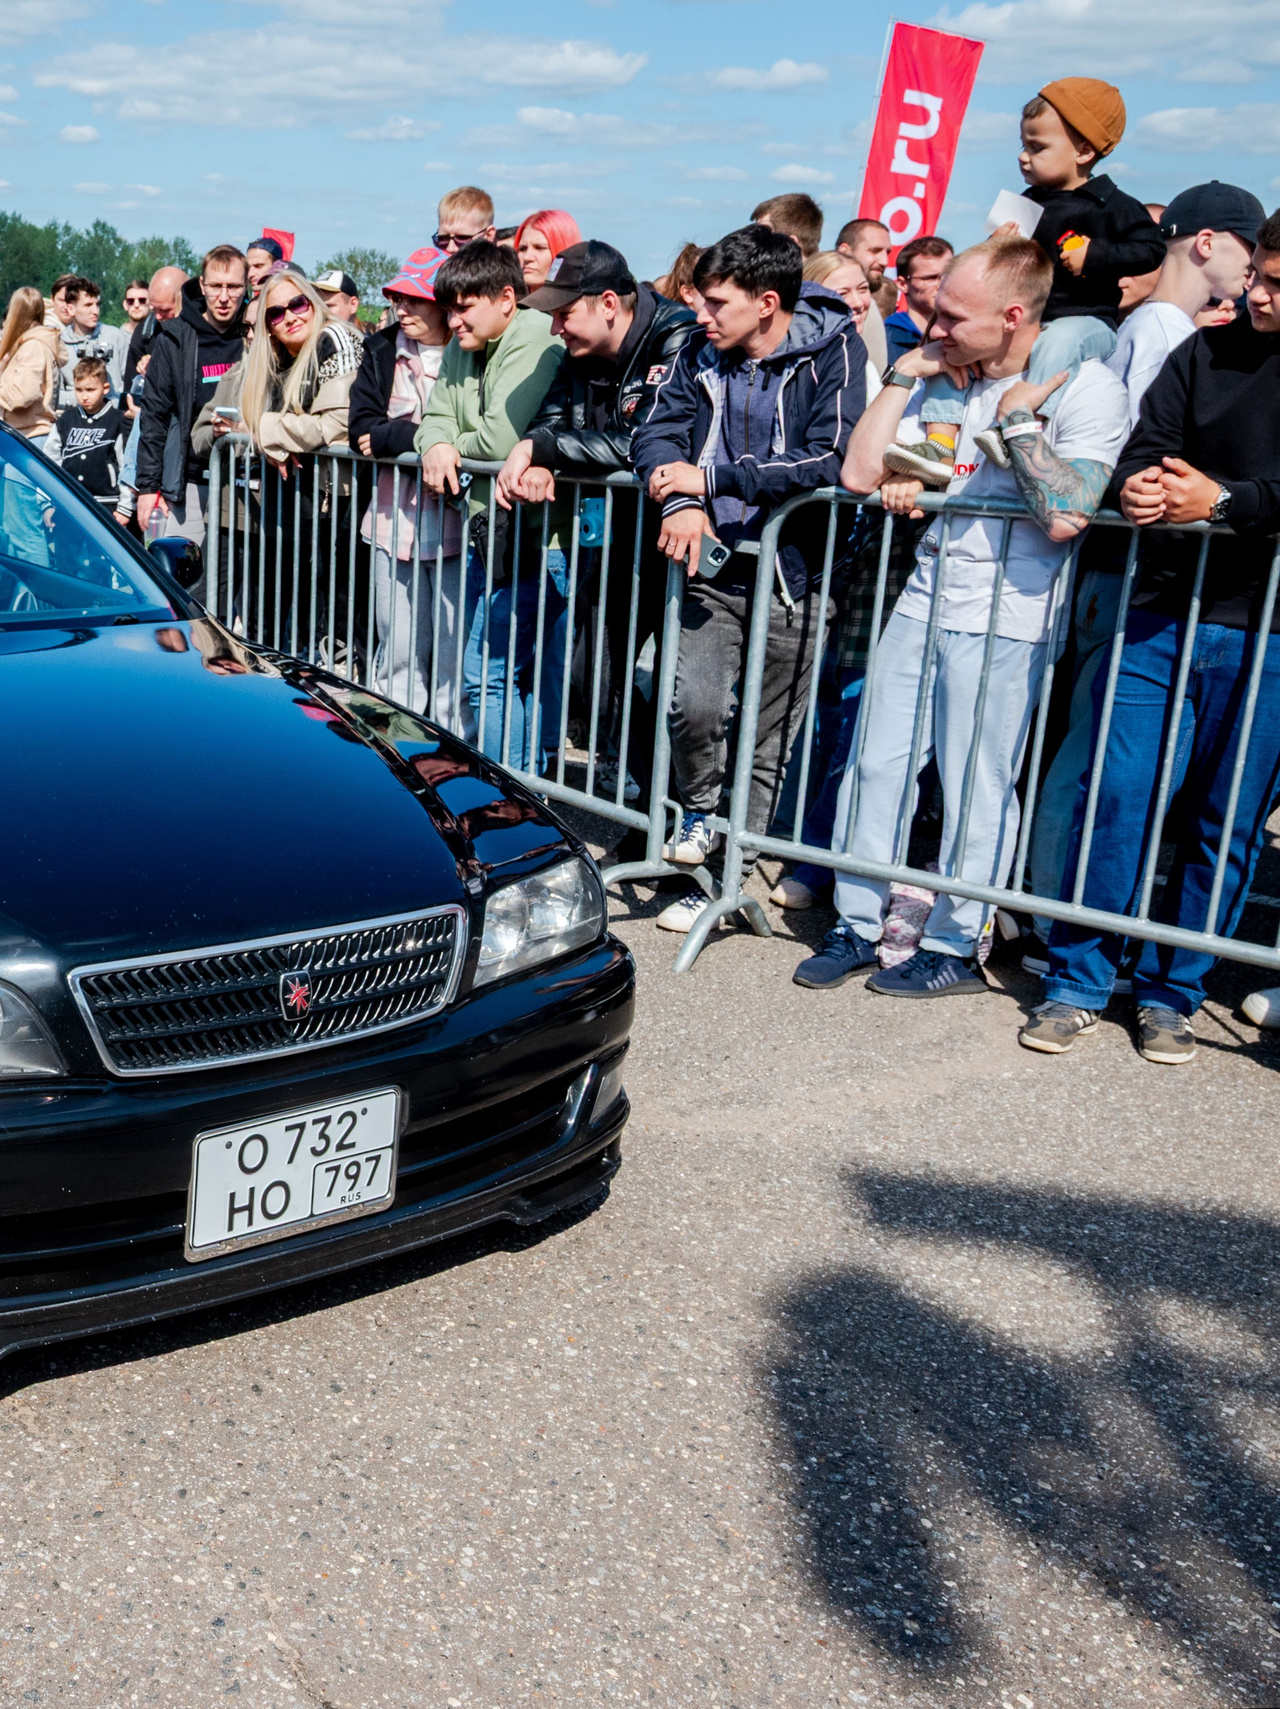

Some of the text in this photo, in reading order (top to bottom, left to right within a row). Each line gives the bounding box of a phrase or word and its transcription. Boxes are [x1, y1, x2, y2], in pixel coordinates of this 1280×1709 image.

[880, 89, 943, 250] o.ru
[66, 427, 106, 446] NIKE
[237, 1110, 358, 1176] O 732
[324, 1153, 382, 1199] 797
[339, 1191, 362, 1206] RUS
[227, 1179, 291, 1233] HO
